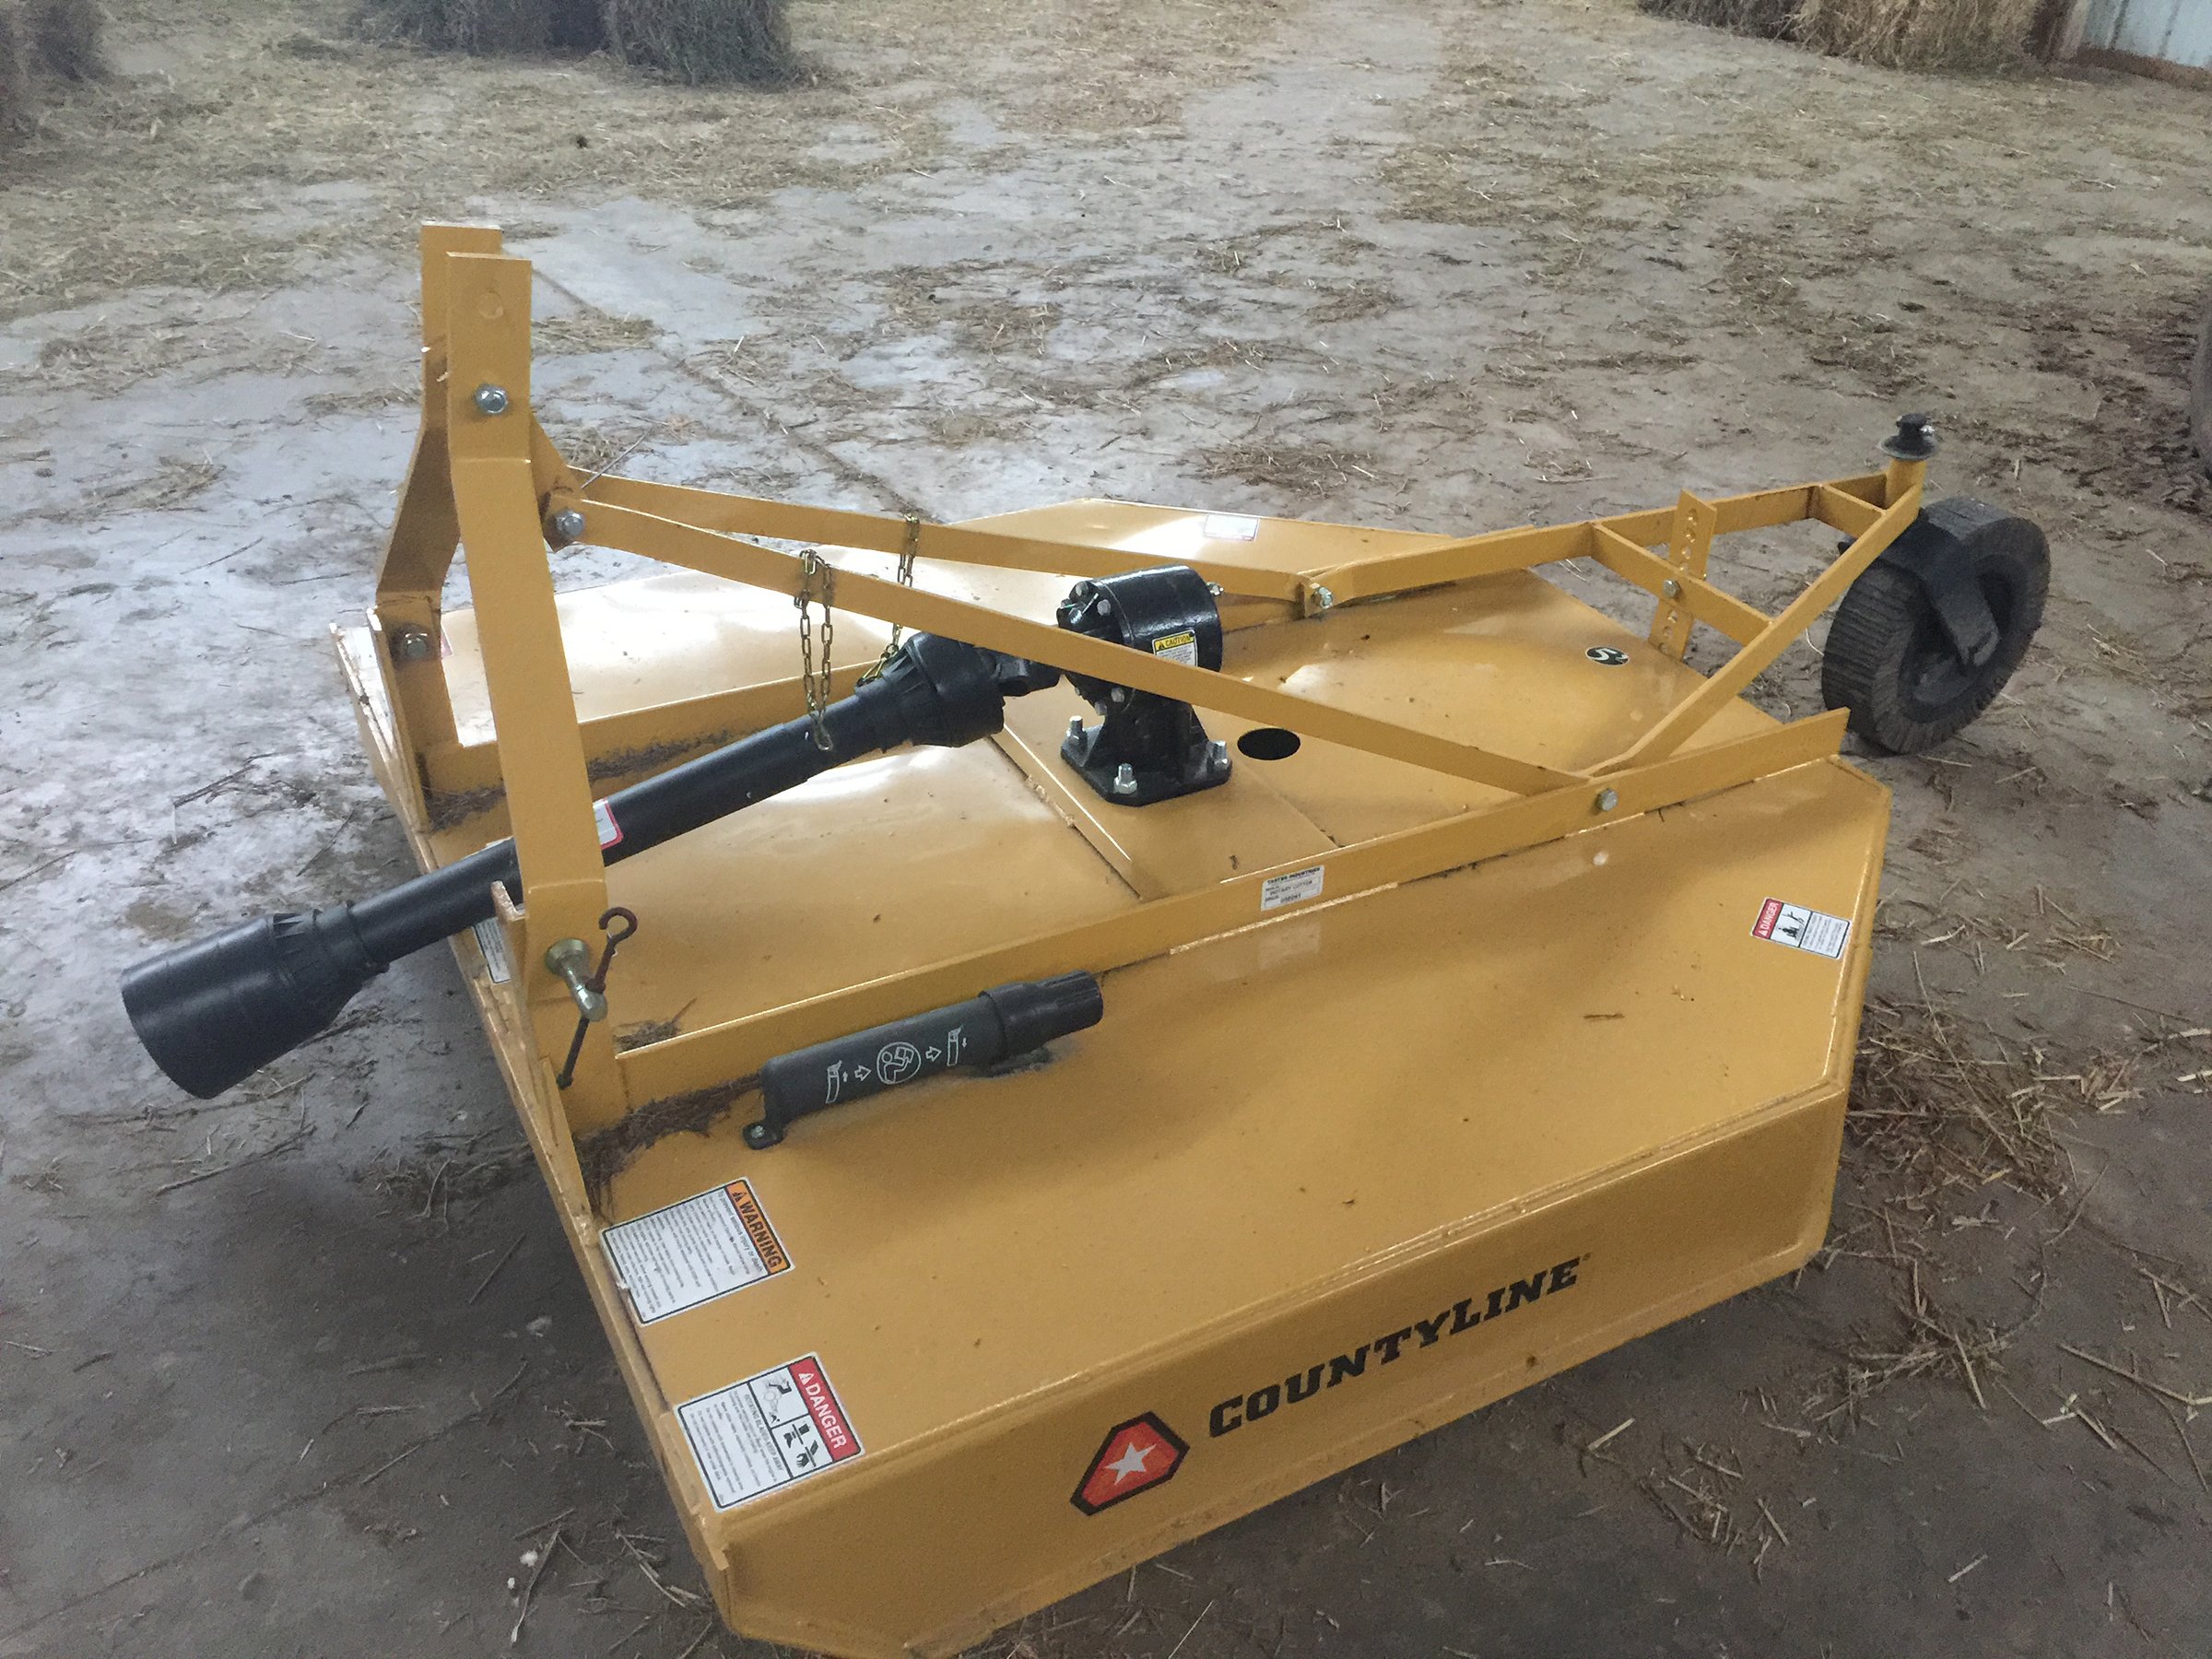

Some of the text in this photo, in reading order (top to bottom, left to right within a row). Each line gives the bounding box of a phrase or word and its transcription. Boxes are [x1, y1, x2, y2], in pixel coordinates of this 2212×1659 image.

[1166, 634, 1191, 646] CAUTION
[1762, 902, 1779, 929] DANGER
[738, 1200, 782, 1269] WARNING
[1208, 1255, 1582, 1439] COUNTYLINE
[805, 1382, 848, 1451] DANGER
